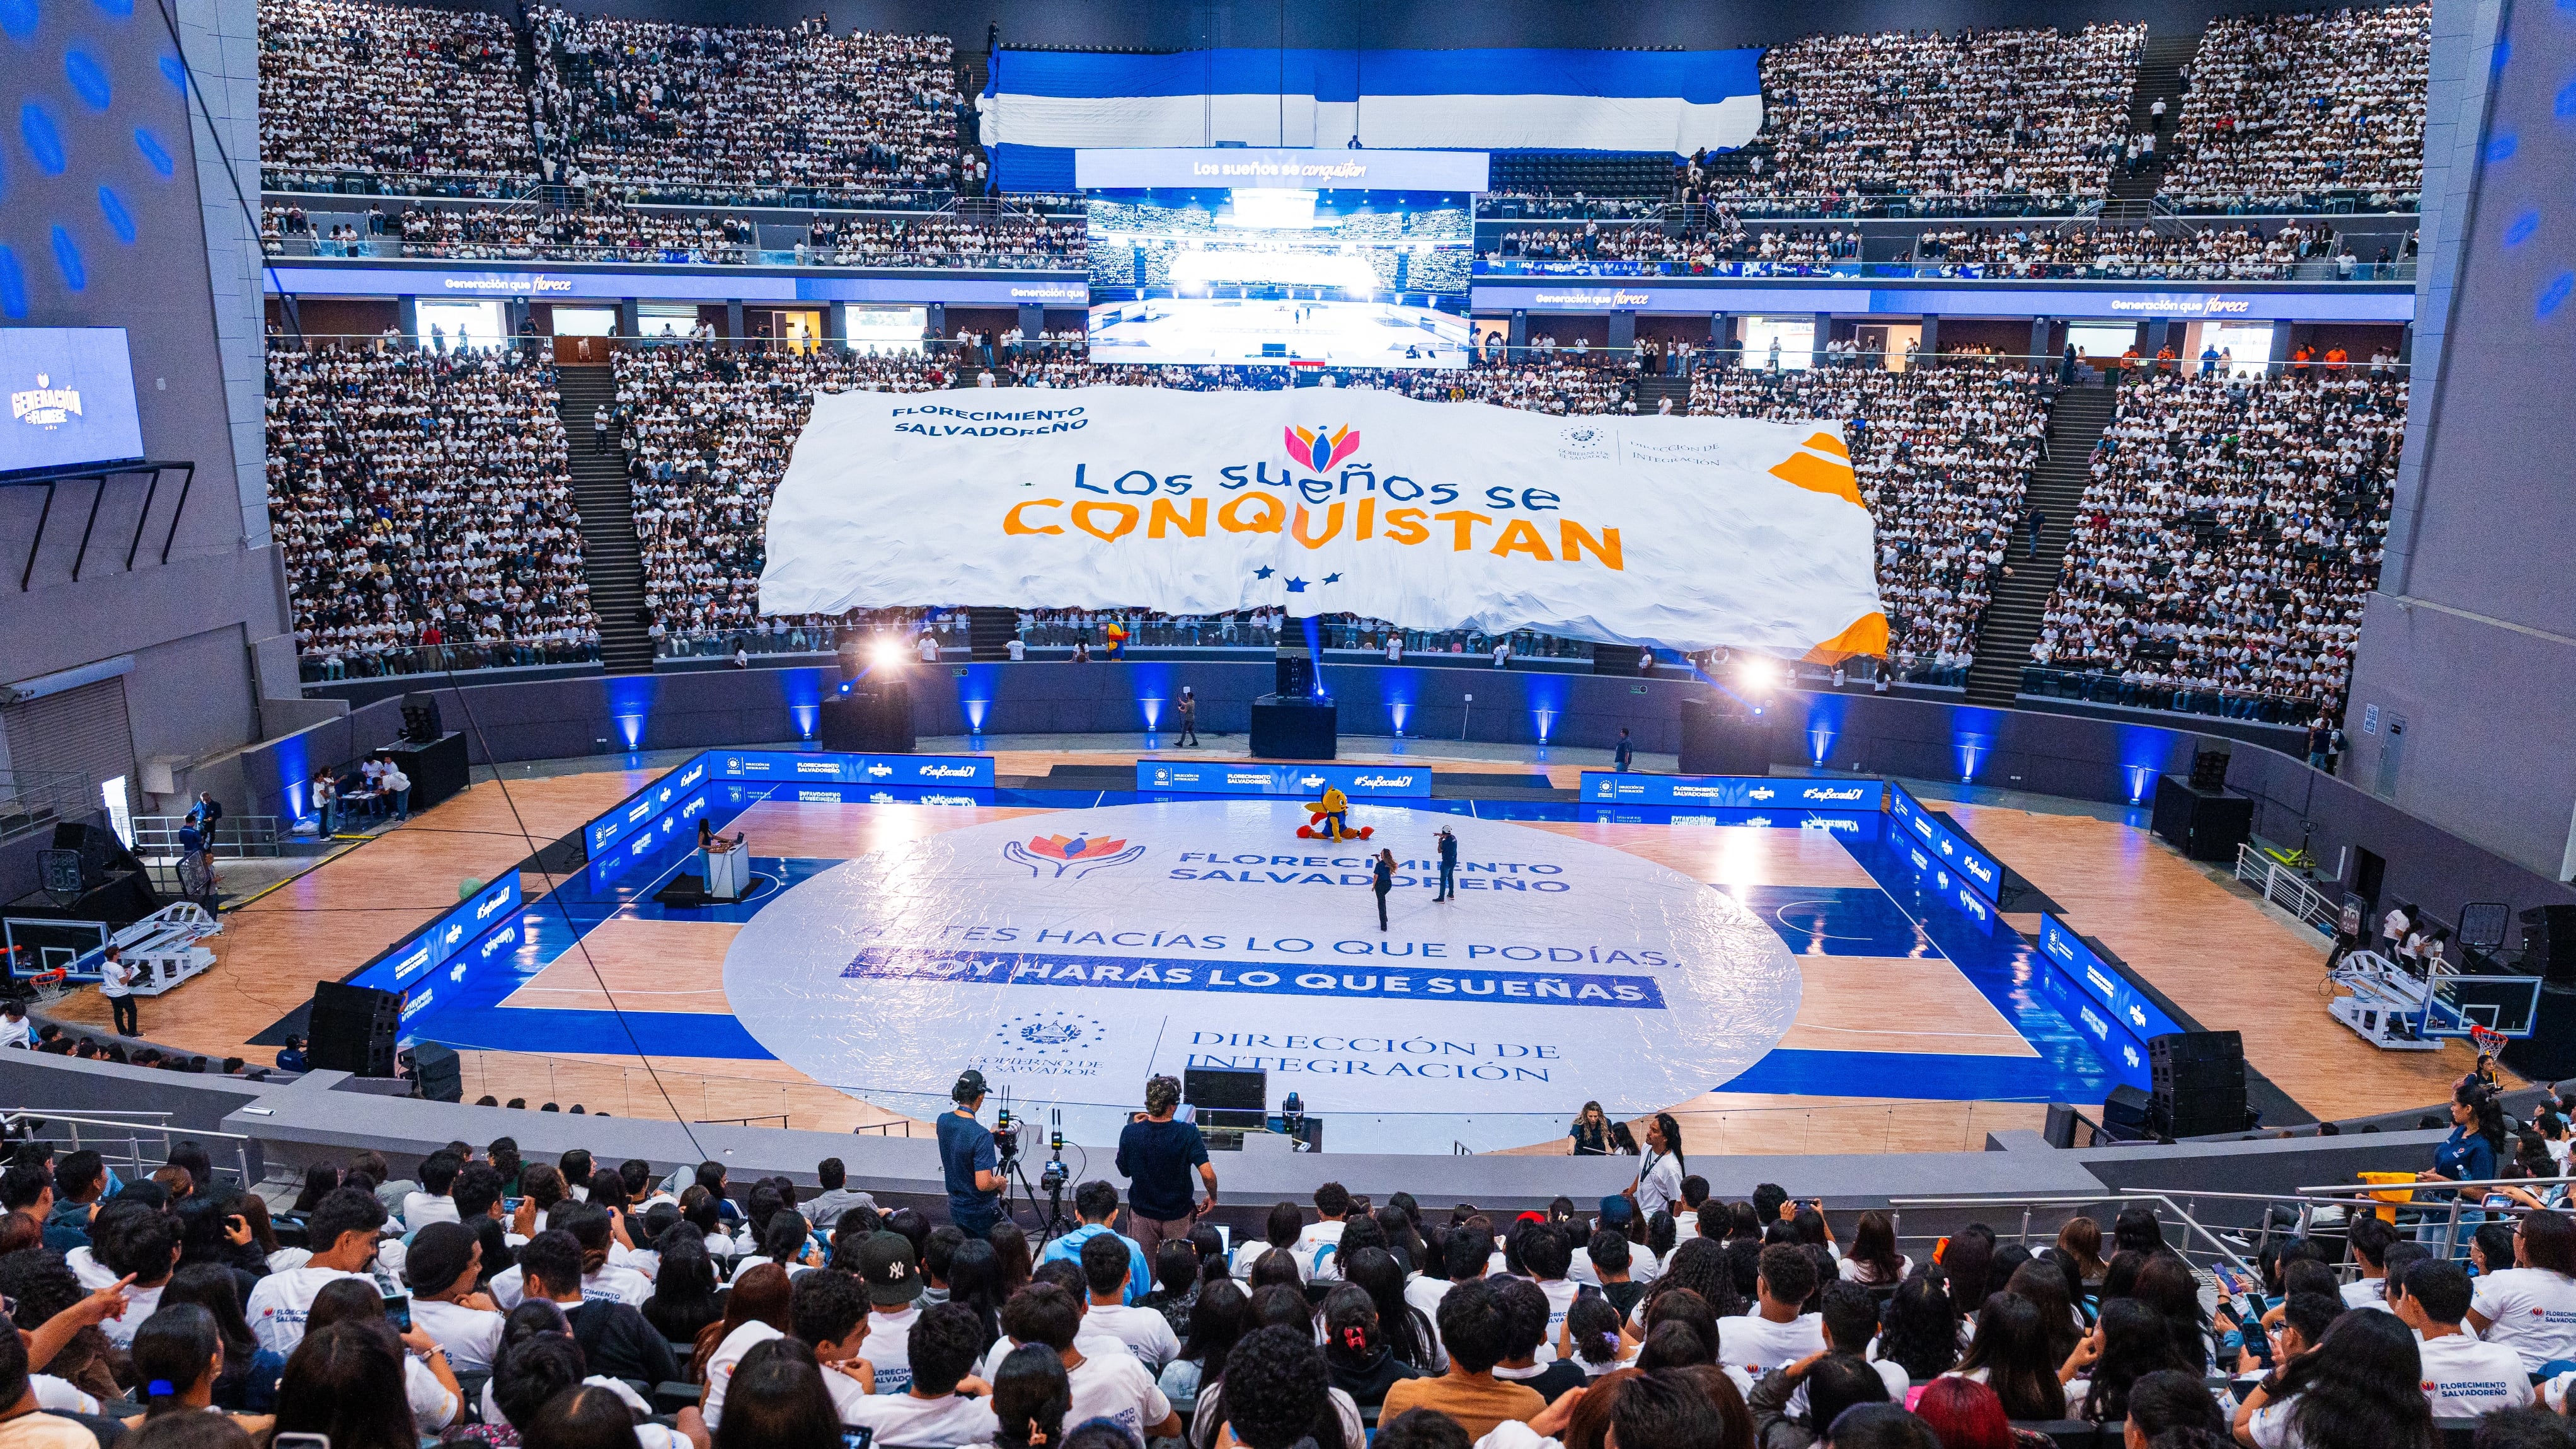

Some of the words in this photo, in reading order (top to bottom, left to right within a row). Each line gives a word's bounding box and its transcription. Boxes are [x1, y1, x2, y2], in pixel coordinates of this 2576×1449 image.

[1194, 161, 1219, 176] Los
[1222, 161, 1279, 176] sueños
[1282, 164, 1300, 176] se
[1302, 158, 1367, 182] conquistan
[445, 278, 509, 289] Generación
[510, 281, 531, 292] que
[532, 274, 572, 294] florece
[1011, 287, 1066, 297] Generación
[1066, 290, 1085, 300] que
[1536, 294, 1592, 304] Generación
[1592, 295, 1611, 306] que
[1611, 289, 1649, 308] florece
[2111, 299, 2178, 311] Generación
[2180, 302, 2203, 313] que
[2203, 294, 2249, 316] florece
[11, 384, 83, 419] GENERACIÓN
[892, 405, 1085, 421] FLORECIMIENTO
[894, 418, 1089, 437] SALVADOREÑO
[1704, 443, 1720, 452] DE
[1633, 452, 1720, 466] INTEGRACIÓN
[1003, 491, 1624, 571] CONQUISTAN
[919, 765, 976, 779] #SoyBecadoDI
[1354, 776, 1413, 789] #SoyBecadoDI
[1803, 788, 1863, 802] #SoyBecadoDI
[1035, 928, 1226, 951] HACÍAS
[1246, 937, 1314, 953] LO
[1333, 940, 1448, 958] QUE
[1469, 944, 1681, 969] PODÍAS,
[1015, 961, 1193, 984] HARÁS
[1208, 970, 1280, 987] LO
[1295, 973, 1411, 994] QUE
[1427, 976, 1645, 1002] SUEÑAS
[1189, 1031, 1478, 1058] DIRECCIÓN
[1494, 1043, 1561, 1060] DE
[969, 1057, 1073, 1067] GOBIERNO
[1079, 1060, 1104, 1068] DE
[997, 1065, 1098, 1077] SALVADOR
[1183, 1053, 1550, 1084] INTEGRACIÓN
[889, 1261, 905, 1279] NY
[2440, 1382, 2507, 1390] FLORECIMIENTO
[2441, 1388, 2507, 1397] SALVADOREÑO
